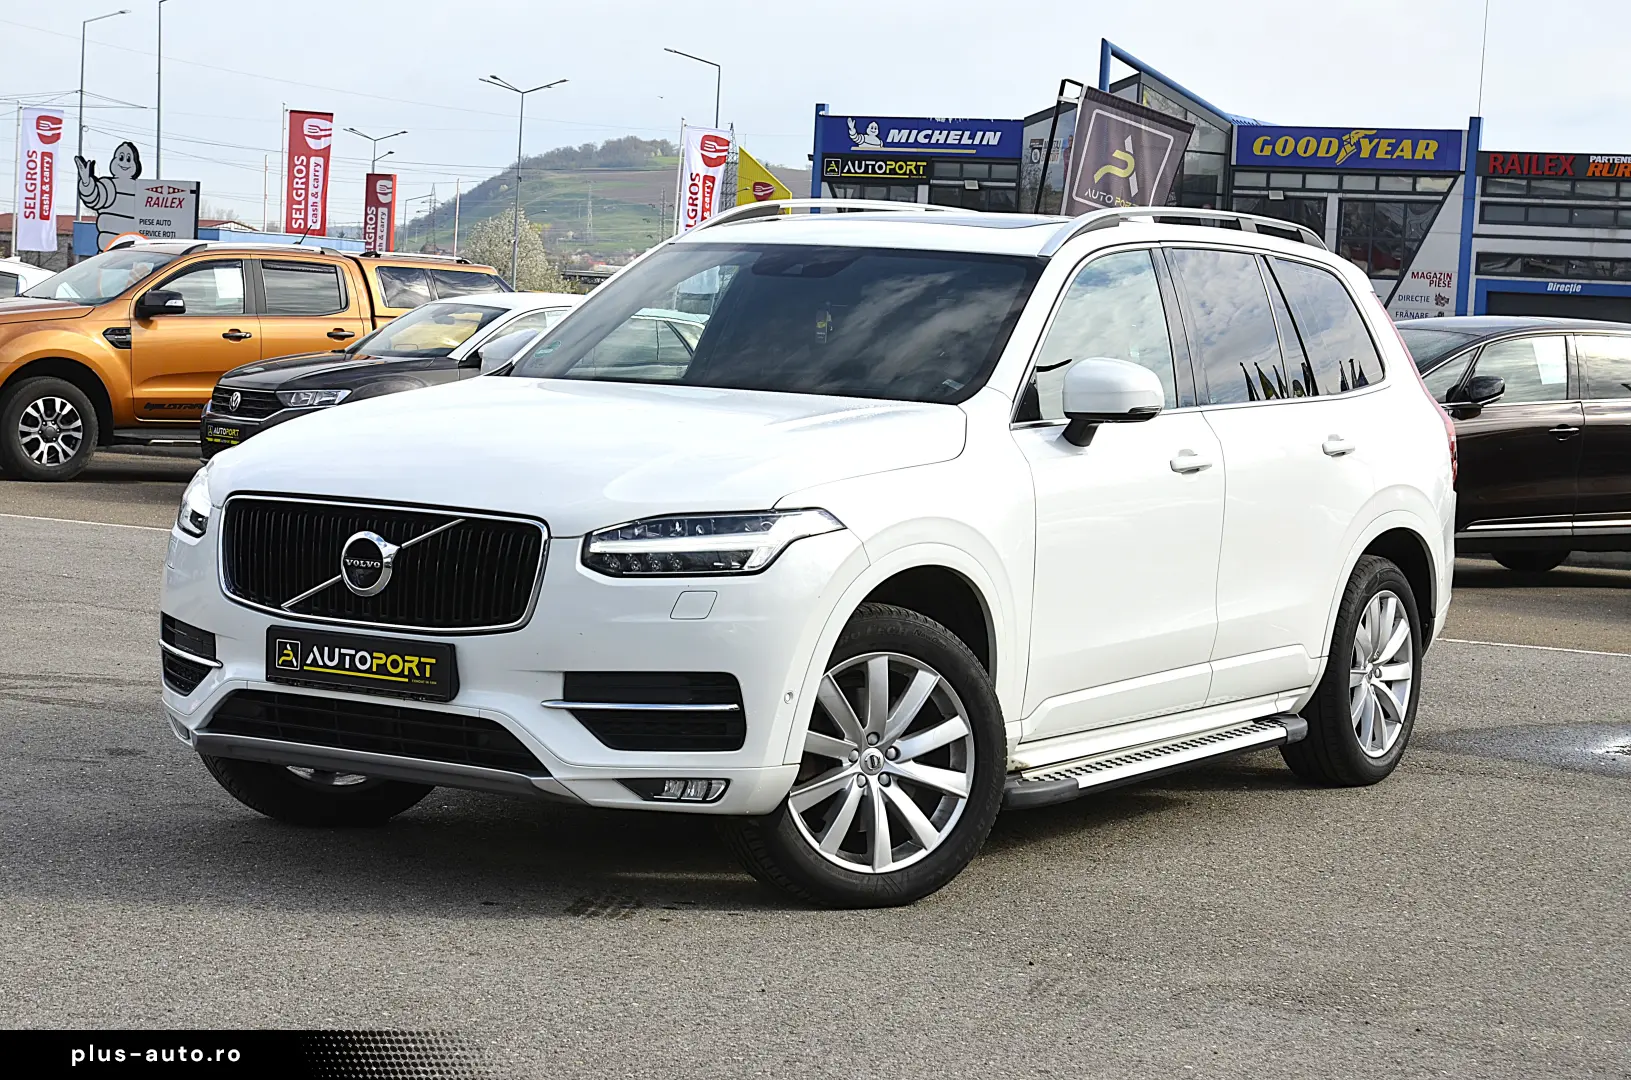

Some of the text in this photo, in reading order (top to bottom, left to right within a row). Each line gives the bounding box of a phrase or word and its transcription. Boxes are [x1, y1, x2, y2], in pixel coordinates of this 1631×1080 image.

[886, 129, 1002, 145] MICHELIN
[843, 160, 927, 175] AUTOPORT
[1488, 153, 1576, 176] RAILEX
[24, 150, 38, 219] SELGROS
[42, 156, 52, 216] cash & carry
[292, 155, 307, 229] SELGROS
[311, 161, 322, 224] cash & carry
[703, 179, 713, 209] carry
[145, 196, 185, 209] RAILEX
[685, 172, 701, 231] LGROS
[1085, 188, 1113, 203] AUTO
[139, 218, 172, 227] PIESE AUTO
[366, 206, 376, 252] LGROS
[1411, 271, 1453, 280] MAGAZIN
[1428, 280, 1452, 288] PIESE
[213, 426, 240, 437] AUTOPORT
[345, 558, 381, 568] VOLVO
[305, 645, 437, 678] AUTOPORT
